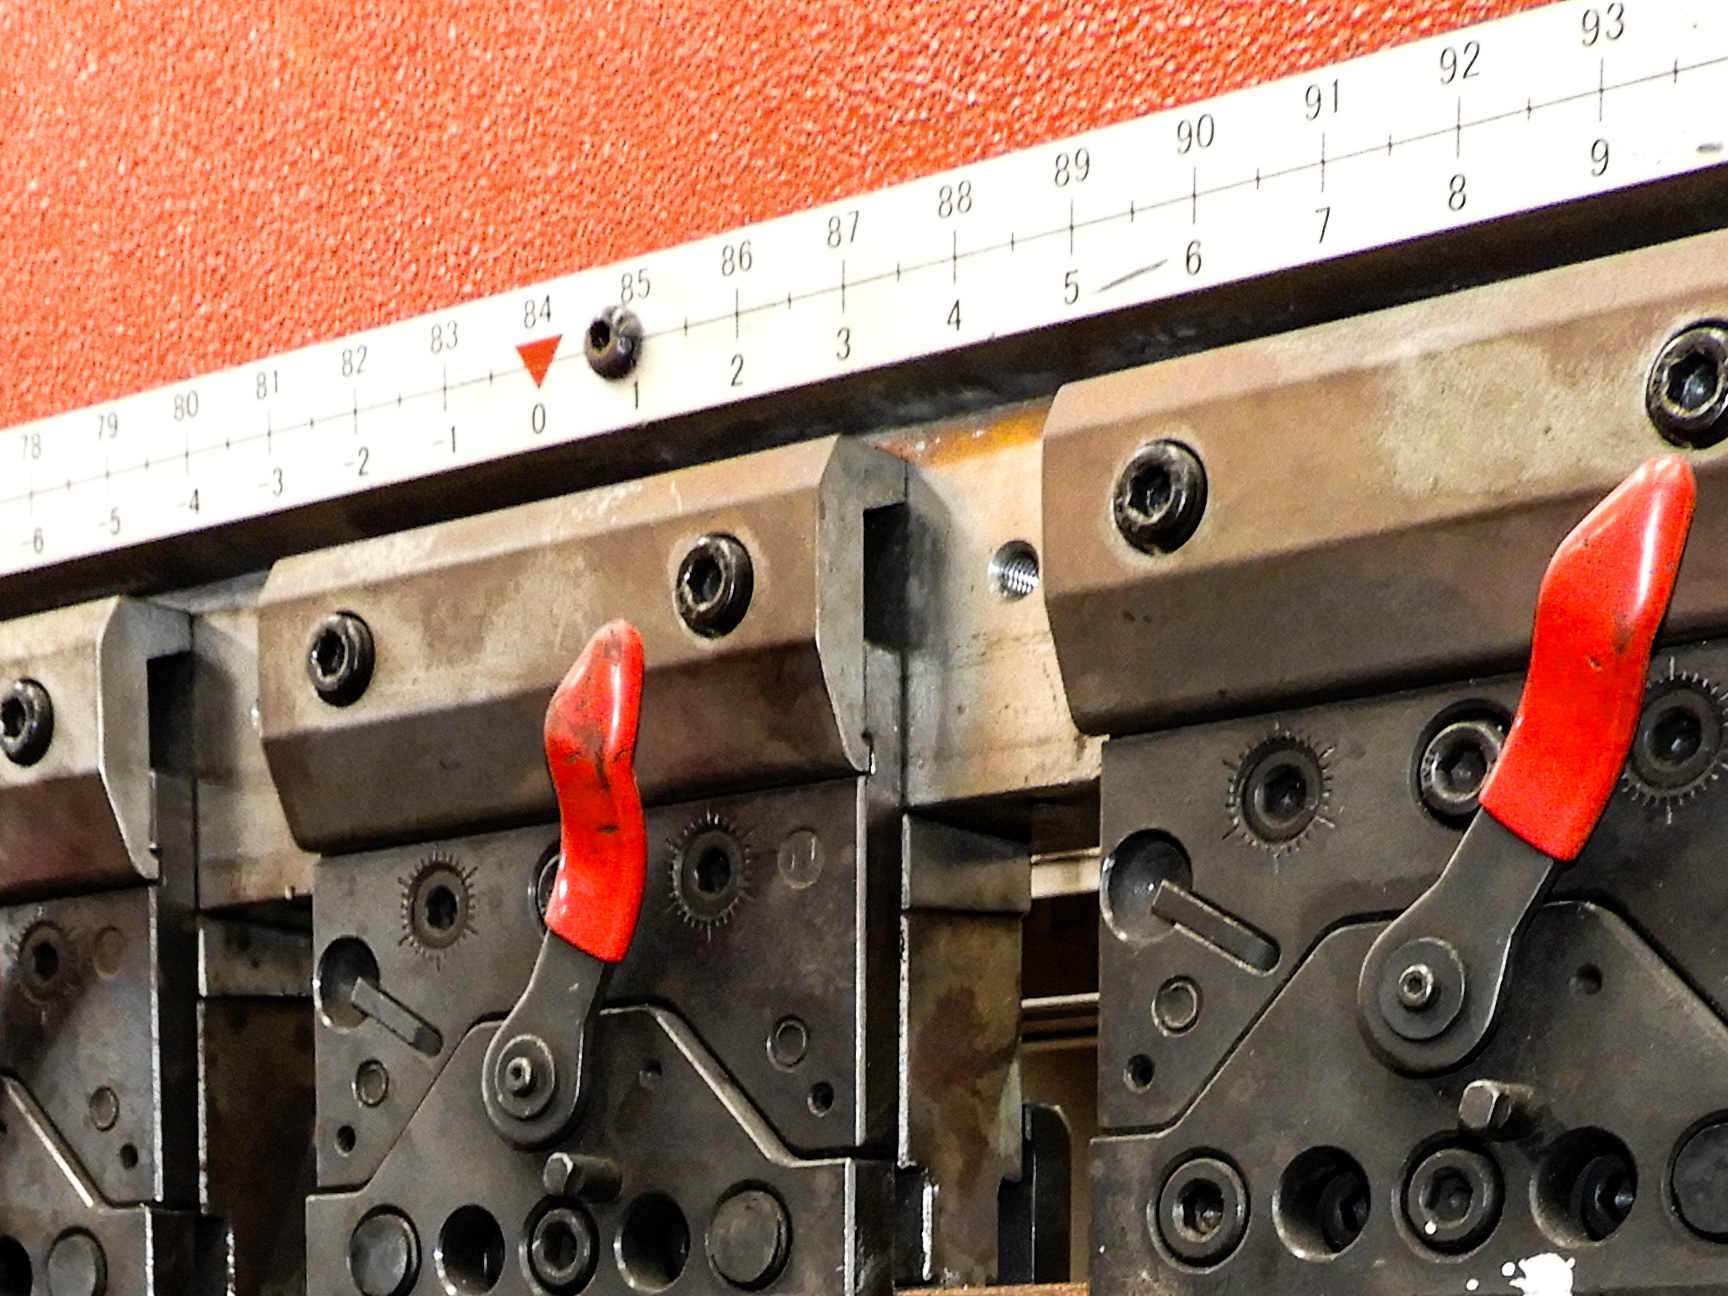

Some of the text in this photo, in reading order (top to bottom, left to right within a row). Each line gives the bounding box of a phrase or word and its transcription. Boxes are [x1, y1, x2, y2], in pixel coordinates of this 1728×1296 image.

[21, 432, 42, 460] 78
[97, 412, 118, 441] 79
[173, 390, 199, 421] 80
[256, 369, 278, 400] 81
[342, 344, 367, 377] 82
[430, 320, 458, 354] 83
[524, 295, 552, 329] 84
[621, 268, 651, 303] 85
[721, 240, 752, 277] 86
[827, 210, 859, 249] 87
[938, 179, 972, 219] 88
[1054, 147, 1090, 187] 89
[1176, 113, 1215, 154] 90
[1305, 78, 1339, 121] 91
[1440, 40, 1481, 85] 92
[1581, 1, 1625, 47] 93
[21, 527, 43, 554] -6
[97, 507, 120, 535] -5
[177, 488, 199, 513] -4
[259, 467, 283, 496] -3
[343, 447, 369, 476] -2
[432, 425, 456, 454] -1
[532, 403, 546, 434] 0
[730, 353, 744, 387] 2
[836, 327, 850, 360] 3
[944, 299, 962, 331] 4
[1064, 269, 1080, 305] 5
[1186, 240, 1202, 276] 6
[1315, 206, 1331, 244] 7
[1448, 174, 1466, 211] 8
[1591, 139, 1609, 177] 9
